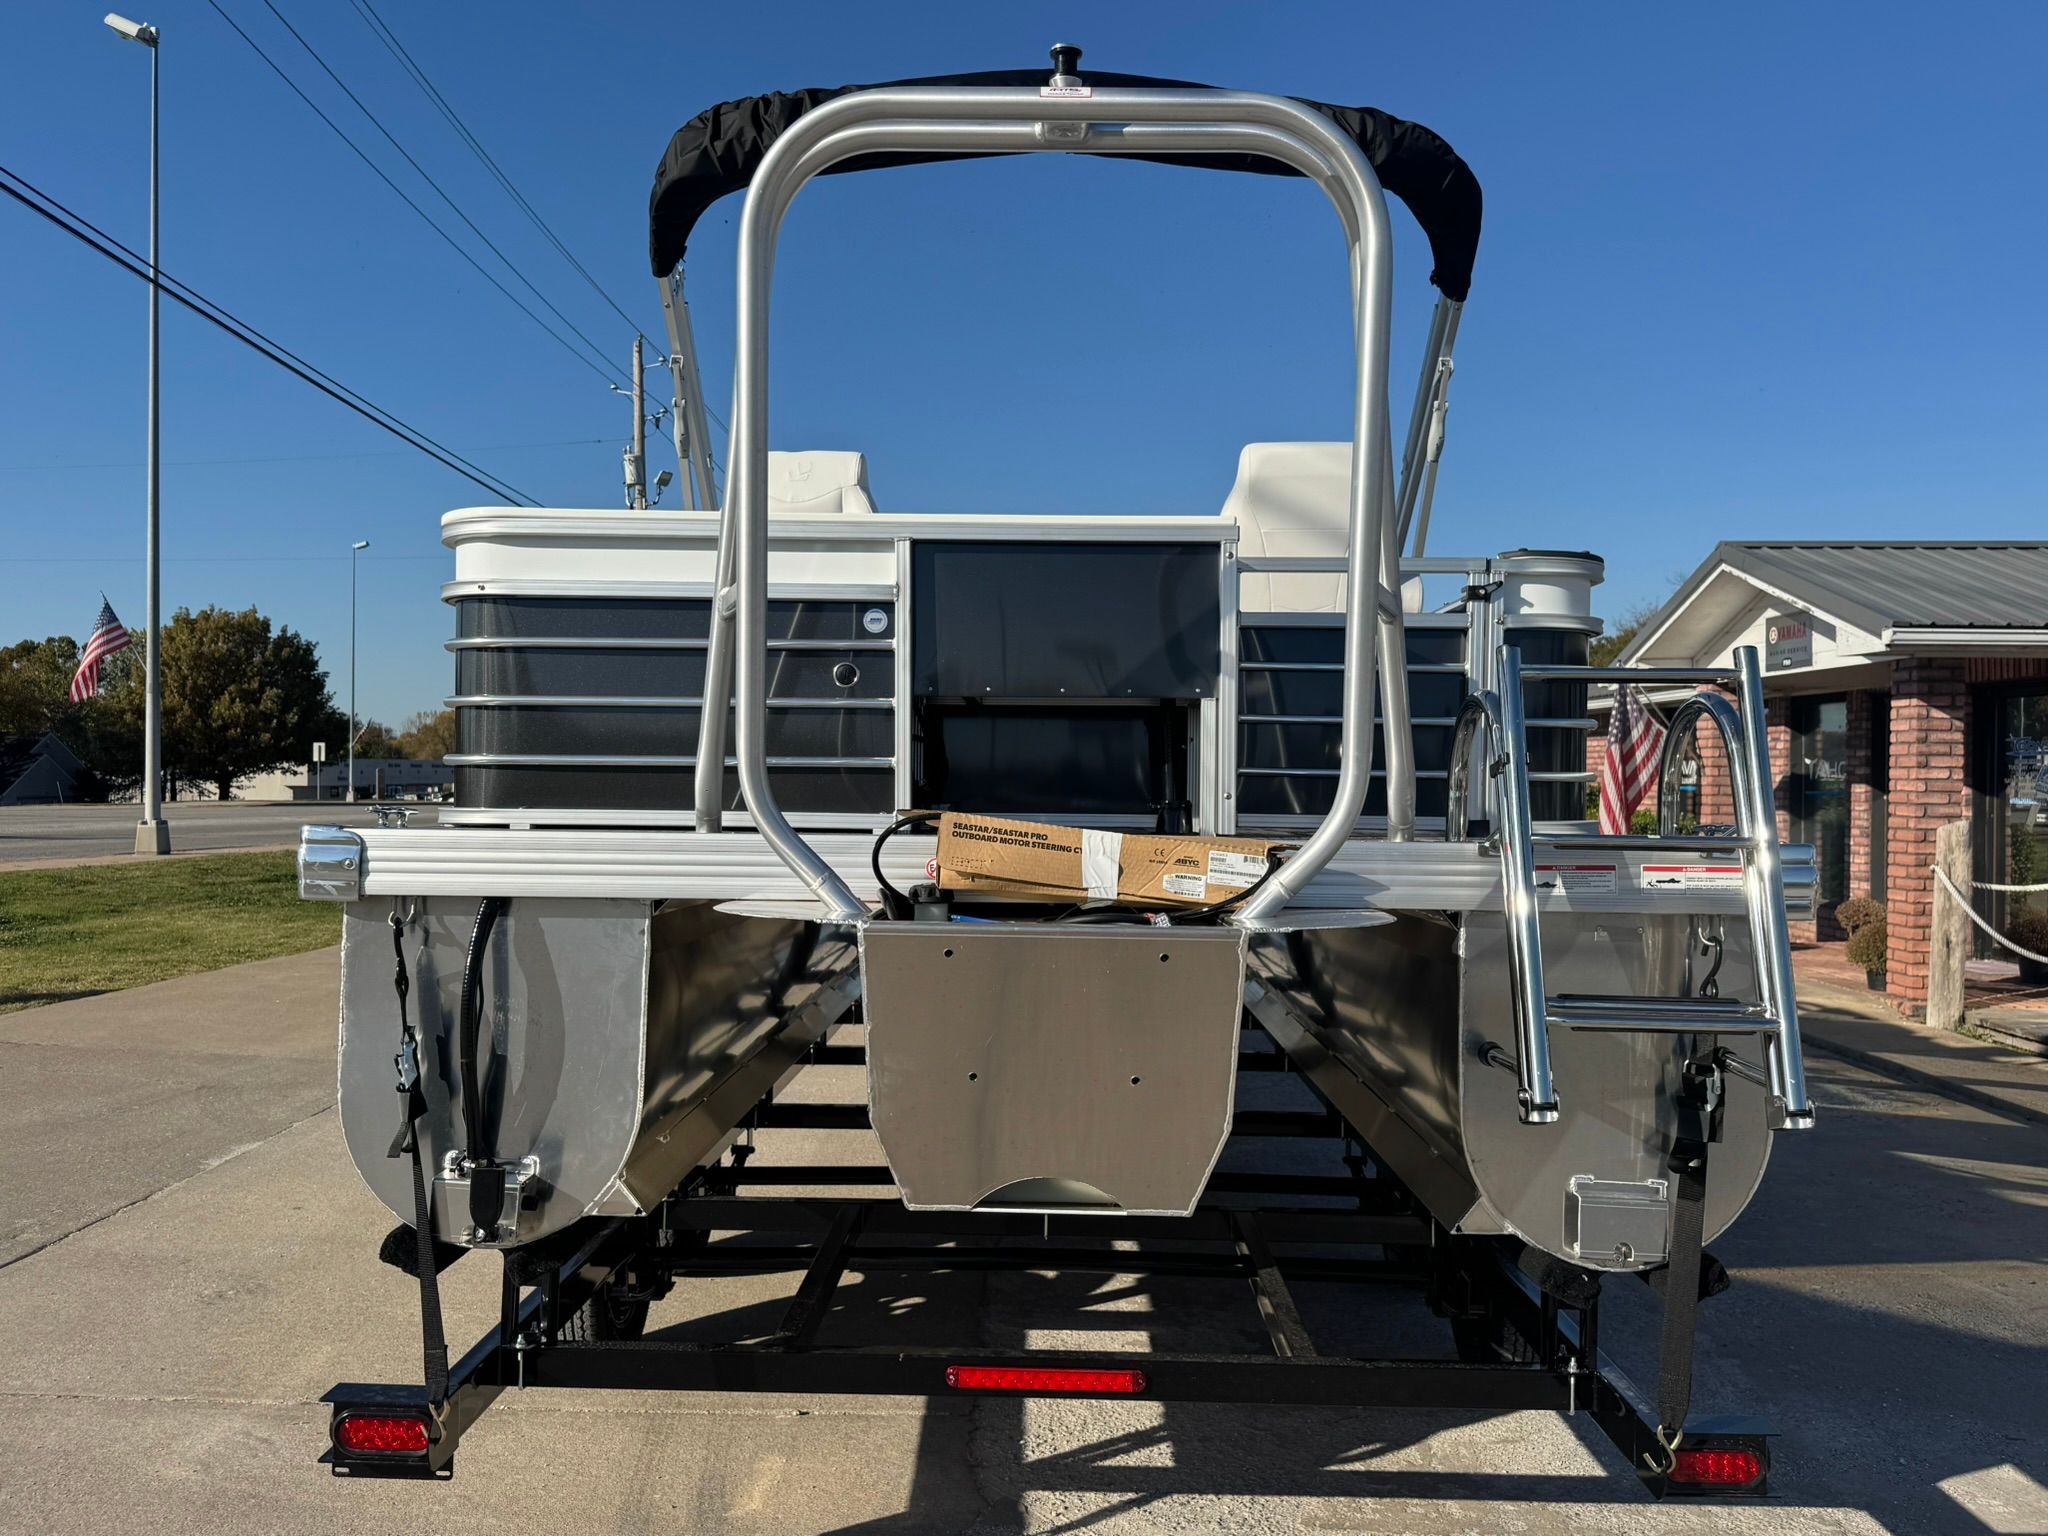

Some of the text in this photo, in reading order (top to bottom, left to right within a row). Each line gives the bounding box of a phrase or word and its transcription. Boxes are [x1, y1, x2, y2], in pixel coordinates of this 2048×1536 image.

[1777, 622, 1808, 641] YAMAHA
[953, 822, 1048, 841] SEASTAR/SEASTAR PRO
[952, 831, 998, 843] OUTBOARD
[999, 837, 1031, 848] MOTOR
[1031, 841, 1072, 853] STEERING
[1174, 858, 1200, 866] ABYC
[1175, 874, 1202, 882] WARNING
